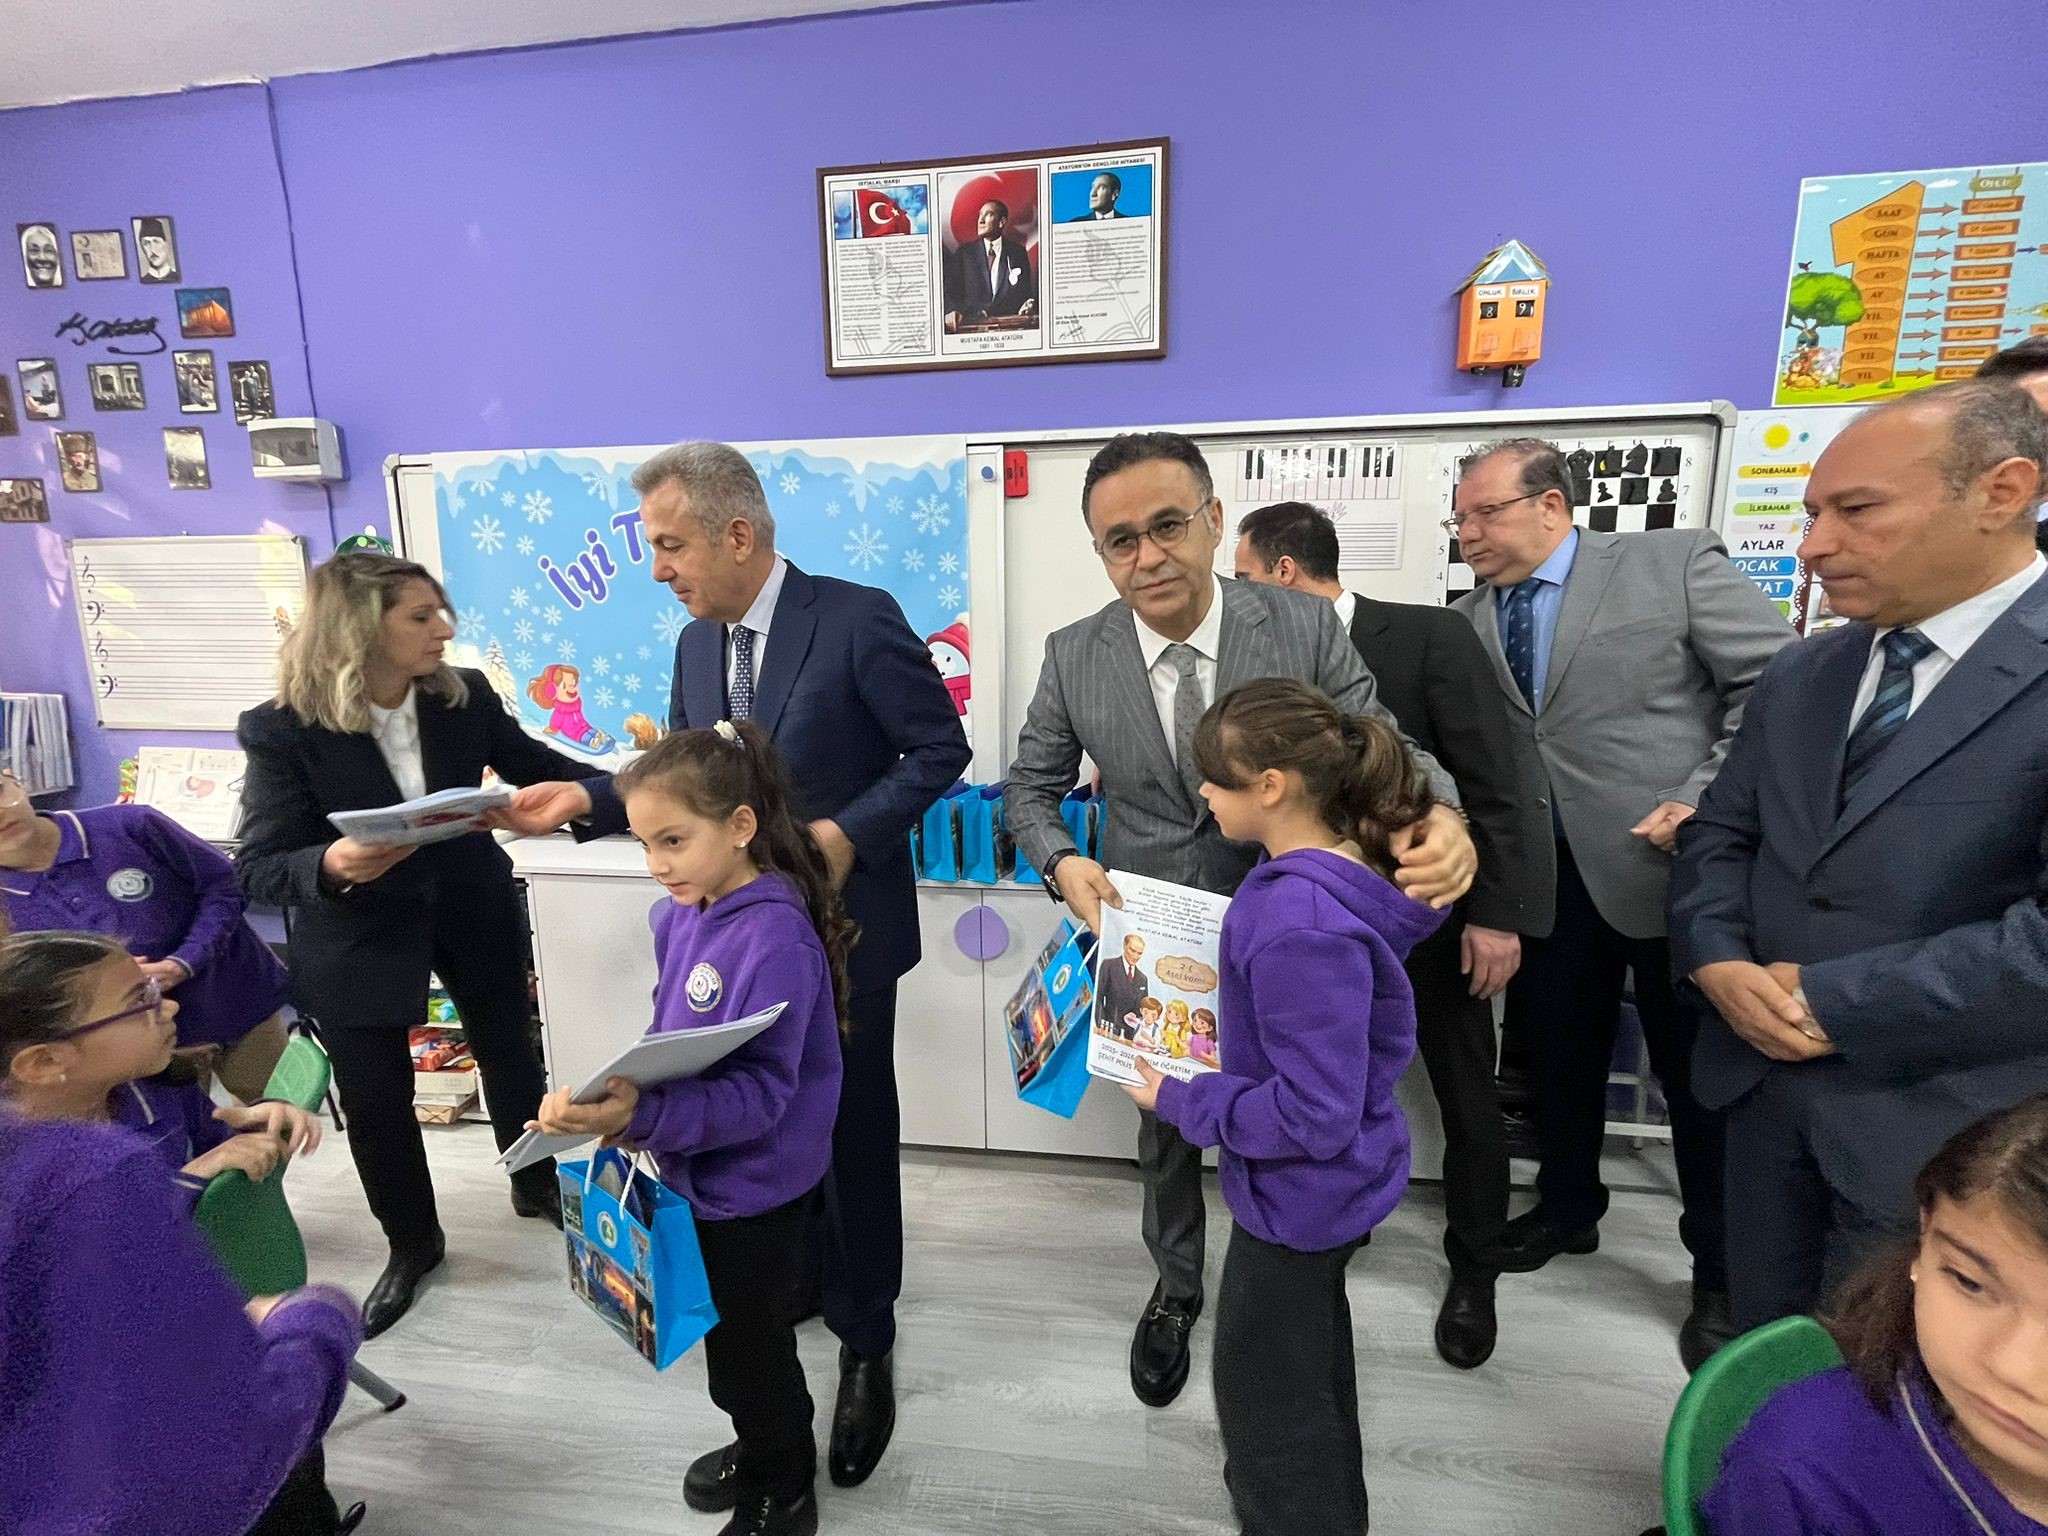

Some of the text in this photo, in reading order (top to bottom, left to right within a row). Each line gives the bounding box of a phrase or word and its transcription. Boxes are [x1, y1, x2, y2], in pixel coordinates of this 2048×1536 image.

[1875, 208, 1902, 218] SAAT
[1866, 250, 1900, 259] HAFTA
[1874, 271, 1886, 279] AY
[1871, 290, 1884, 298] AY
[1486, 302, 1527, 318] 8 9
[1865, 312, 1882, 321] YIL
[1863, 332, 1879, 340] YIL
[1860, 351, 1875, 360] YIL
[1856, 371, 1872, 380] YIL
[1443, 456, 1692, 477] 8 8
[1751, 467, 1797, 475] SONBAHAR
[1442, 485, 1690, 504] 7 7
[1764, 487, 1778, 495] KIŞ
[1749, 504, 1791, 512] İLKBAHAR
[1680, 510, 1687, 520] 6
[1758, 523, 1776, 531] YAZ
[1740, 540, 1784, 550] AYLAR
[1438, 545, 1445, 555] 5
[540, 530, 616, 608] İyi
[1735, 560, 1780, 572] OCAK
[1436, 571, 1443, 580] 4
[1161, 1062, 1191, 1075] ÖĞRETİM
